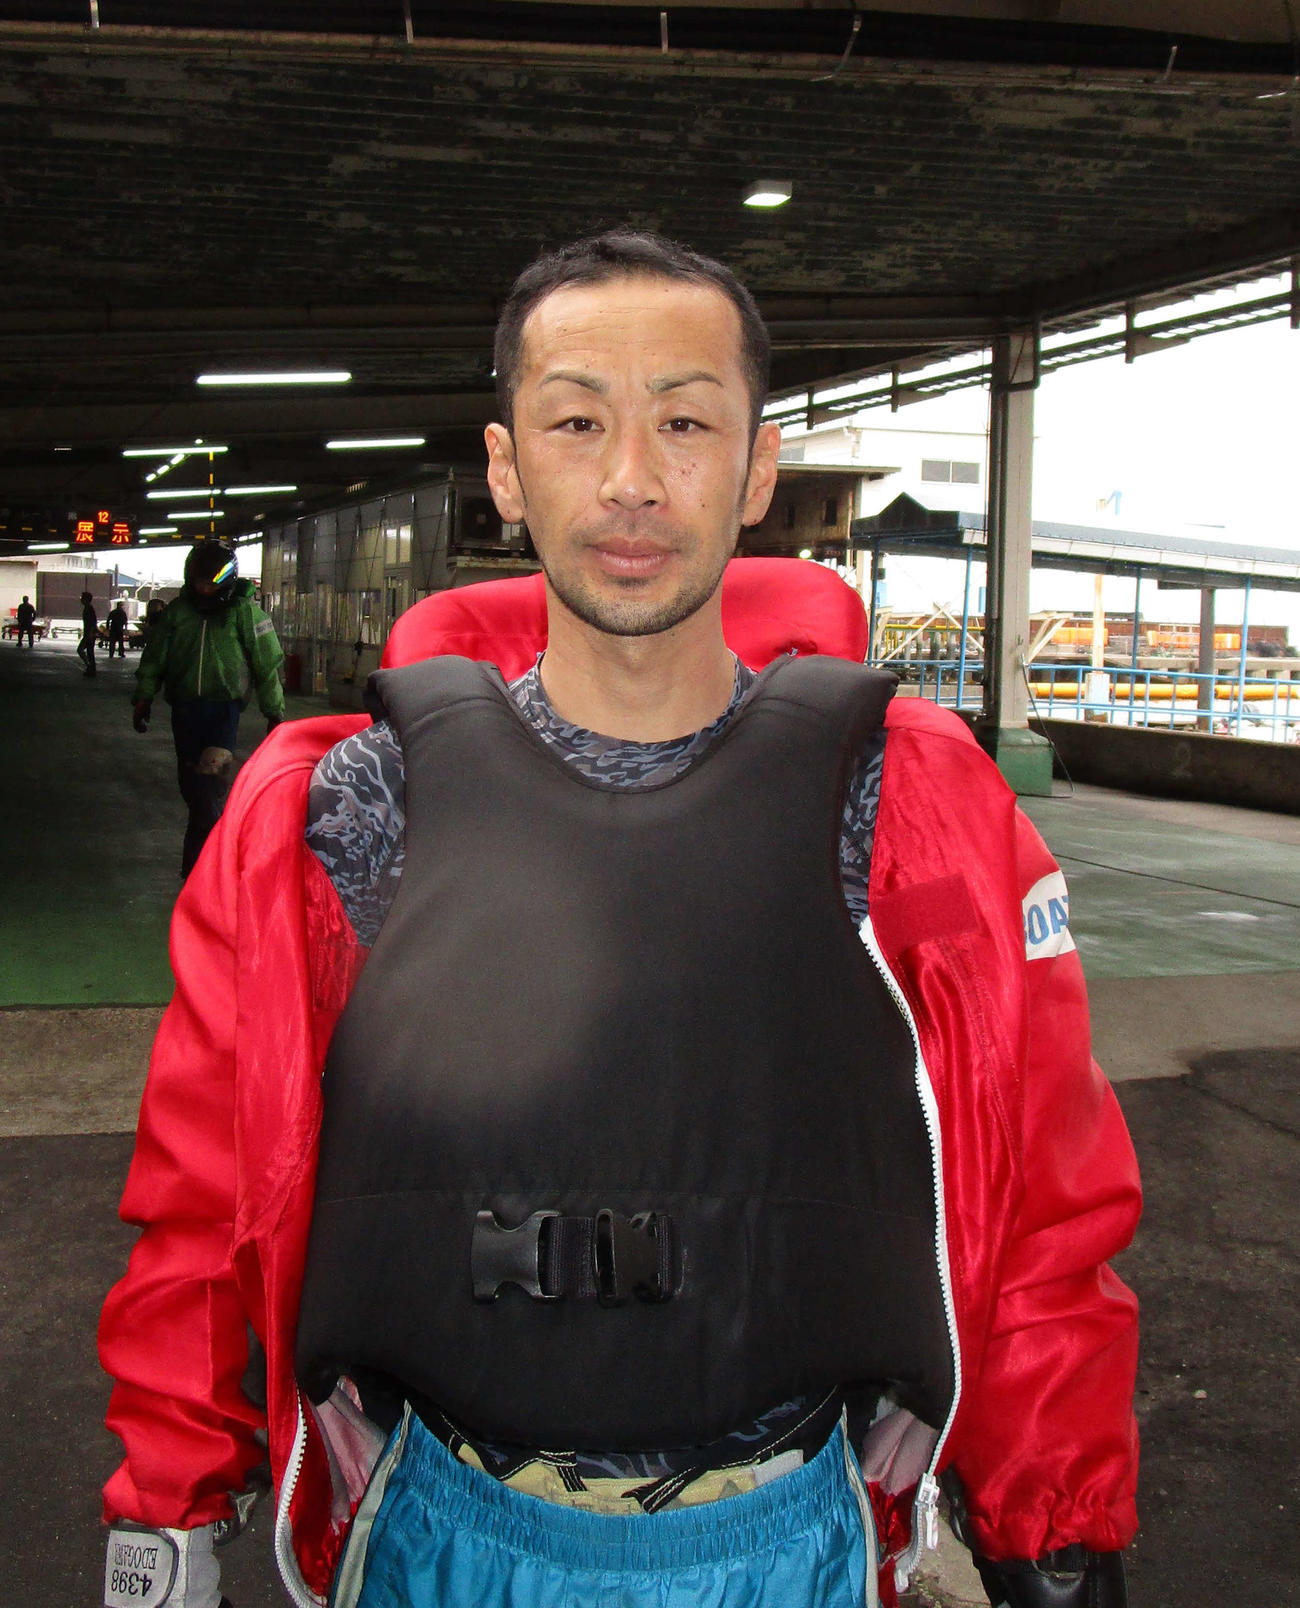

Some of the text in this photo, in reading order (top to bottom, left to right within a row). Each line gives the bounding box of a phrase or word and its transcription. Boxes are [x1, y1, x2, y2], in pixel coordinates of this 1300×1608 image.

[97, 511, 109, 523] 12
[1024, 895, 1070, 945] OA
[111, 1570, 153, 1597] 4398
